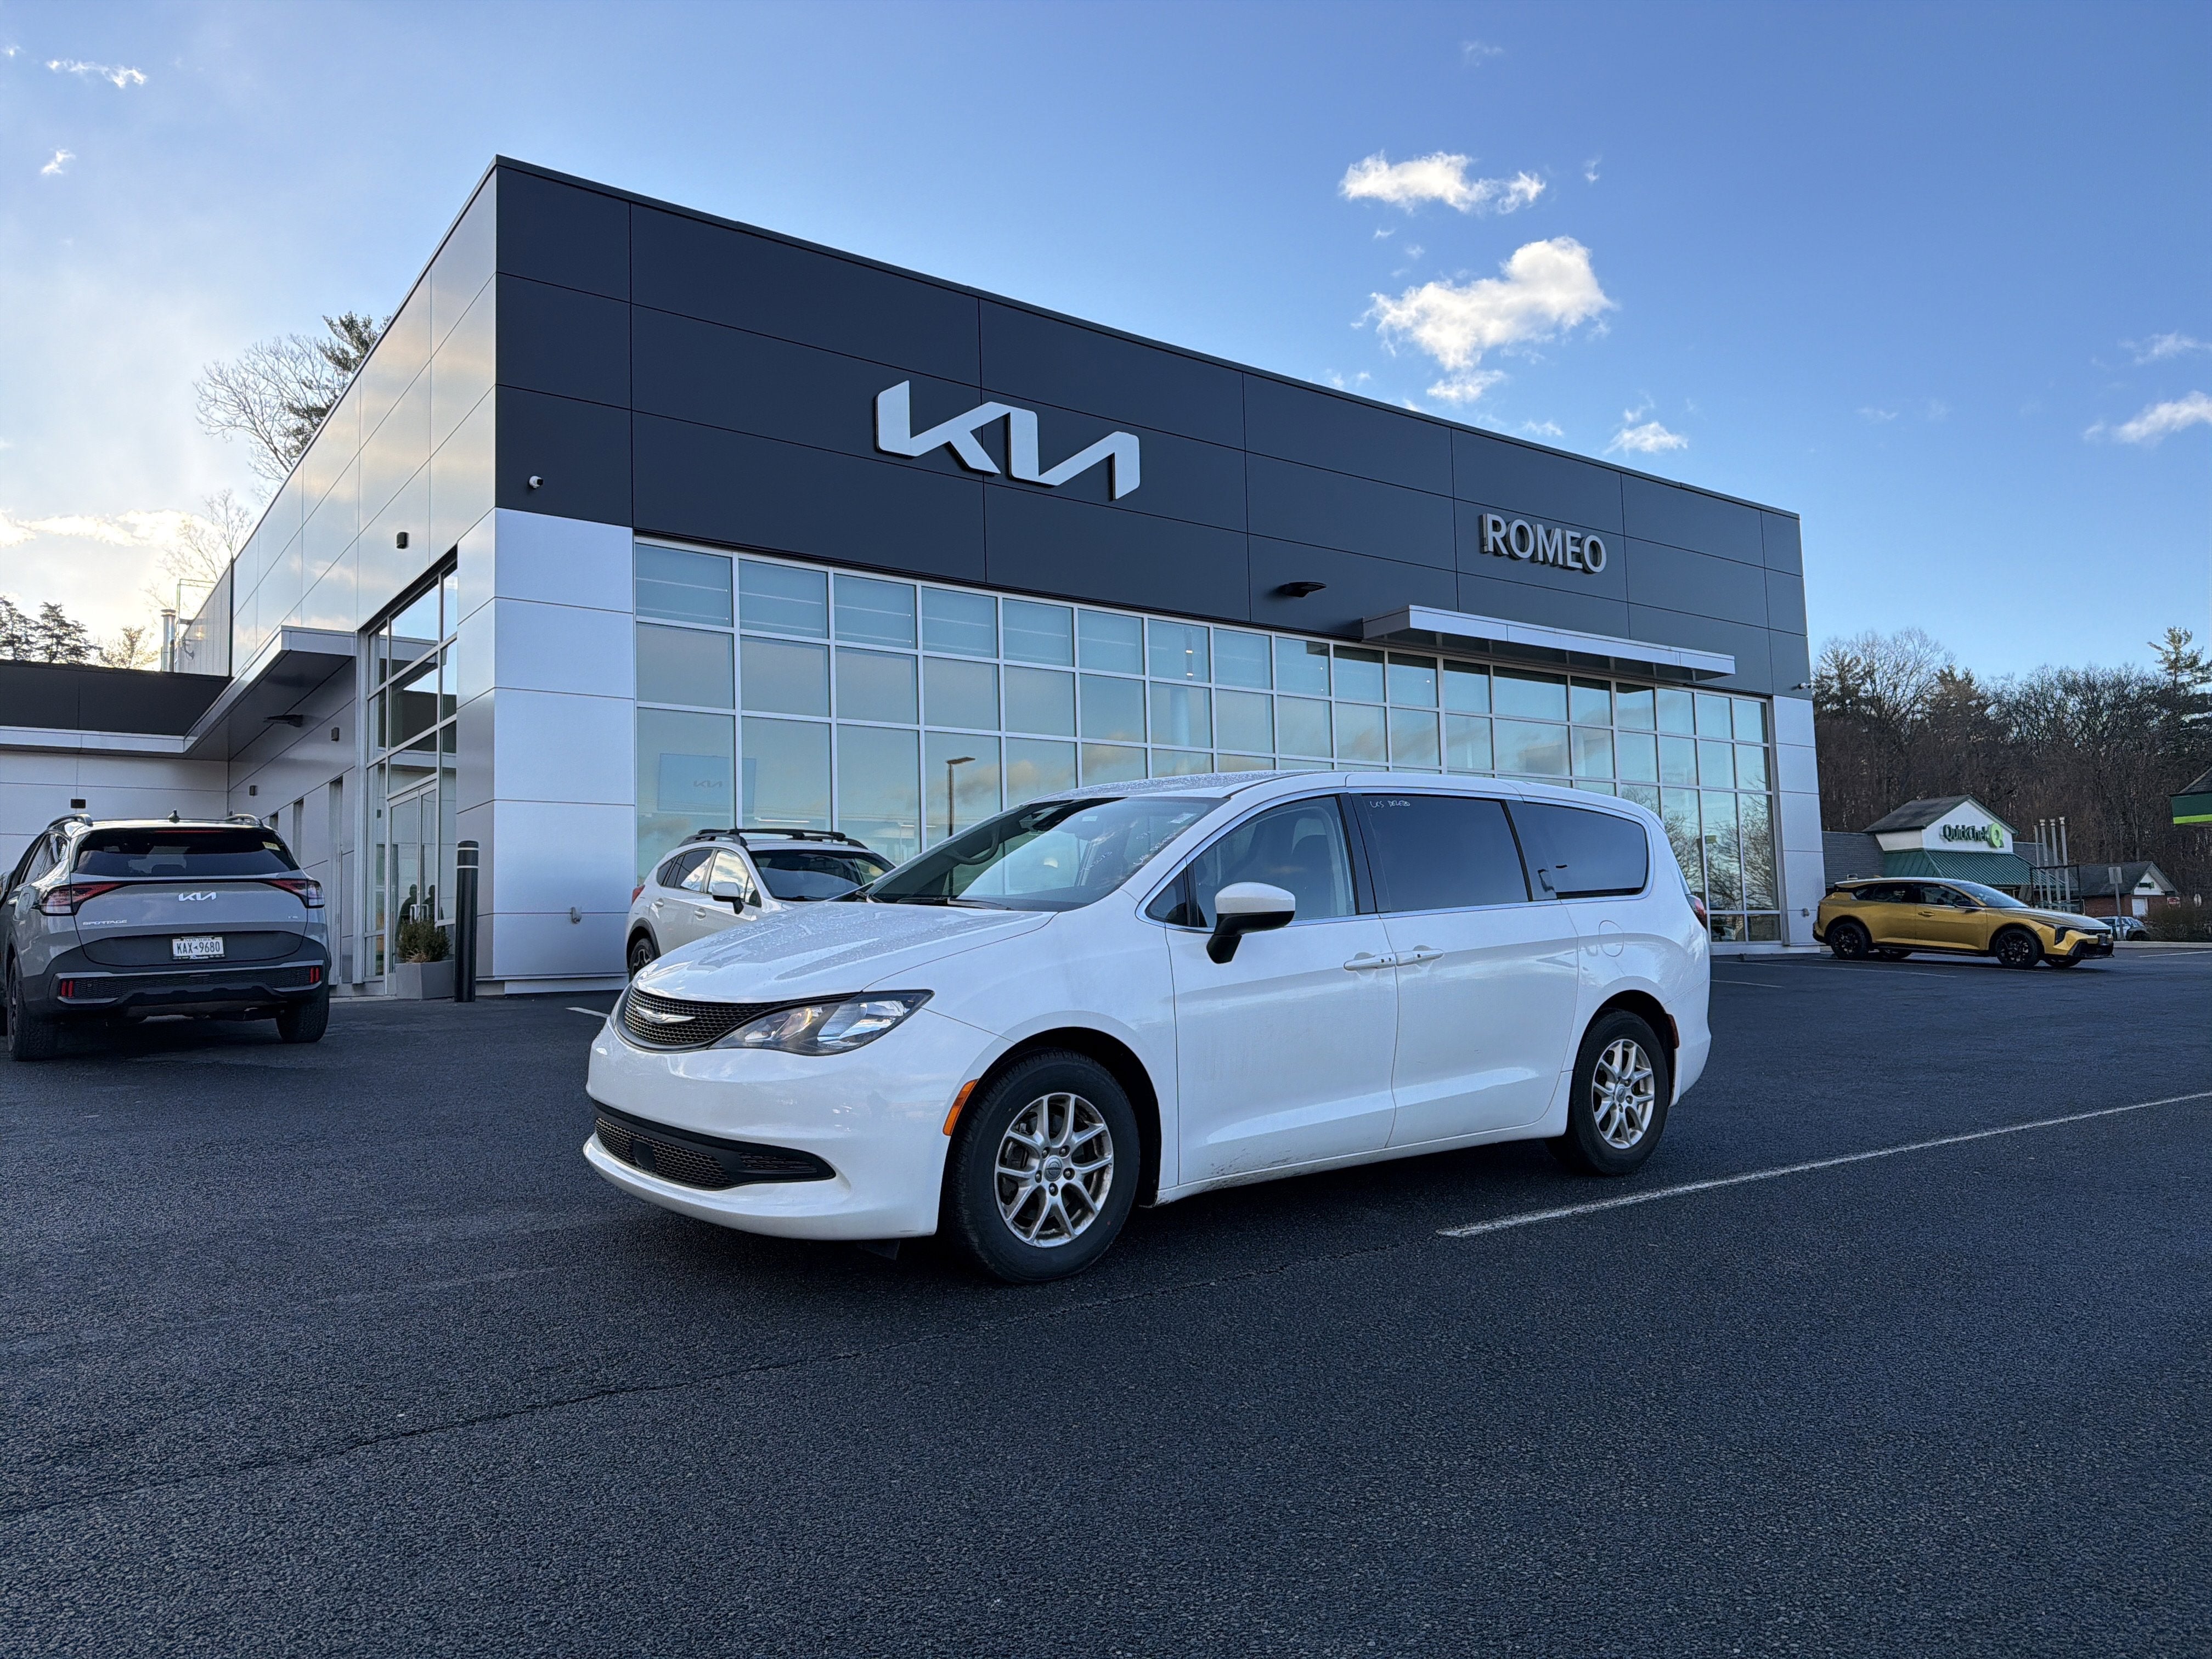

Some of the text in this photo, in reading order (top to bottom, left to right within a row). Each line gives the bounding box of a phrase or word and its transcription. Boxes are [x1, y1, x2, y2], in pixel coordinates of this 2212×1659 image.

[877, 380, 1140, 500] KIA
[1483, 513, 1606, 573] ROMEO
[178, 891, 217, 901] KIA
[176, 941, 221, 955] KAX 9680
